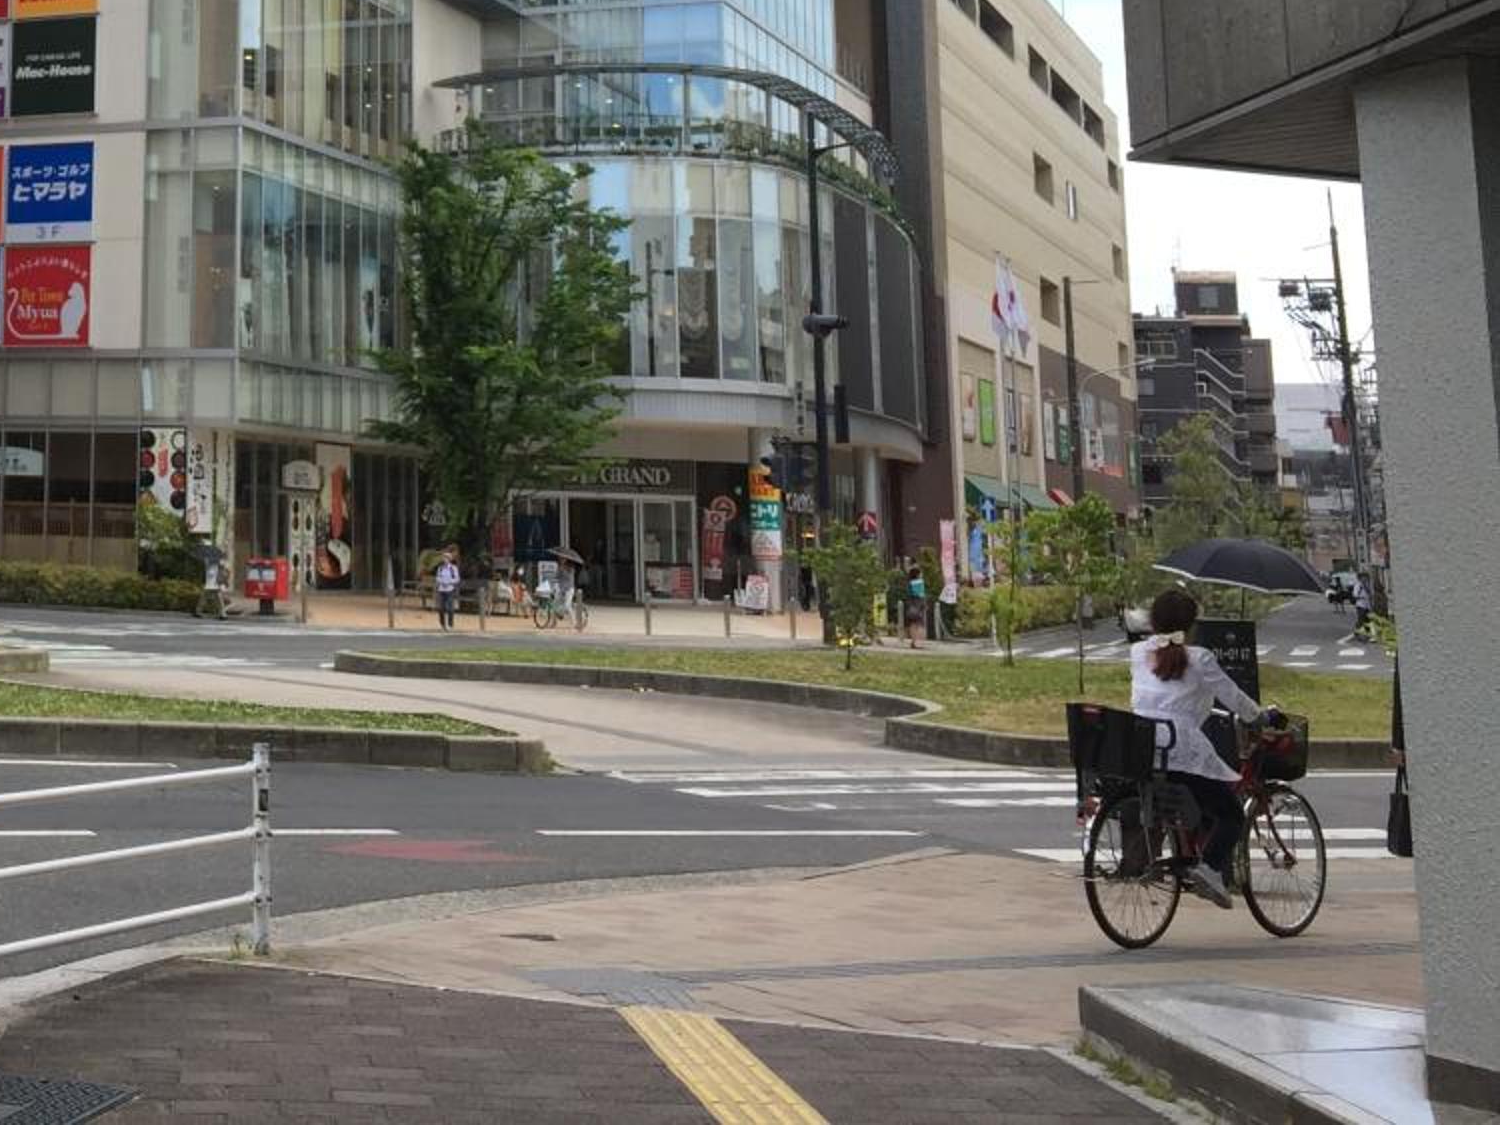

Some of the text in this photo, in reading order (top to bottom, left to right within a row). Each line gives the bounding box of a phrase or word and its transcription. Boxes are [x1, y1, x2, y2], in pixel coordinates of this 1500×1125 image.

[13, 181, 87, 203] ヒマラヤ
[600, 465, 671, 486] GRAND
